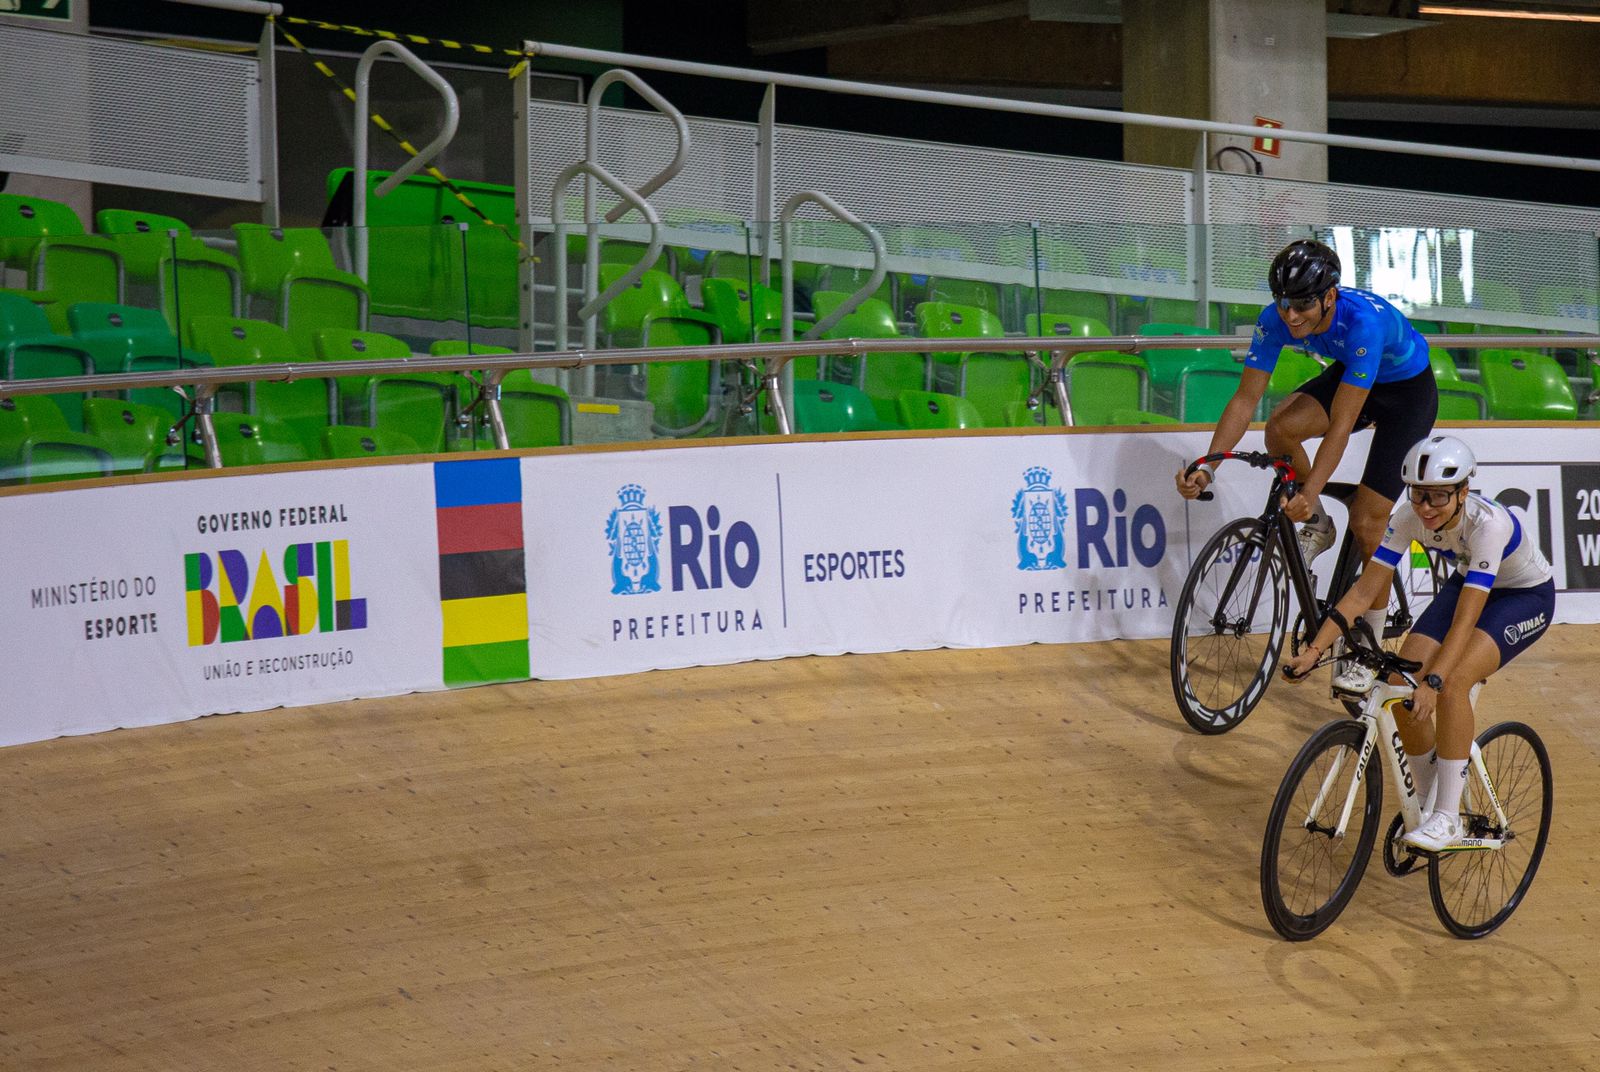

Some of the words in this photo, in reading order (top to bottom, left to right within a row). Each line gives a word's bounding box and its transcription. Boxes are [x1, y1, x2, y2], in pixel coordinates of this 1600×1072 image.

[197, 509, 273, 535] GOVERNO
[279, 503, 348, 528] FEDERAL
[1075, 488, 1167, 569] Rio
[668, 504, 760, 592] Rio
[803, 548, 906, 583] ESPORTES
[31, 577, 128, 610] MINISTÉRIO
[133, 575, 156, 598] DO
[184, 539, 367, 646] BRASIL
[1019, 579, 1169, 615] PREFEITURA
[84, 612, 158, 641] ESPORTE
[612, 609, 763, 642] PREFEITURA
[1516, 612, 1546, 633] VINAC
[204, 661, 241, 681] UNIÃO
[246, 660, 254, 676] E
[258, 650, 353, 678] RECONSTRUÇÃO
[1356, 739, 1373, 782] CALOI
[1391, 730, 1416, 798] CALOI
